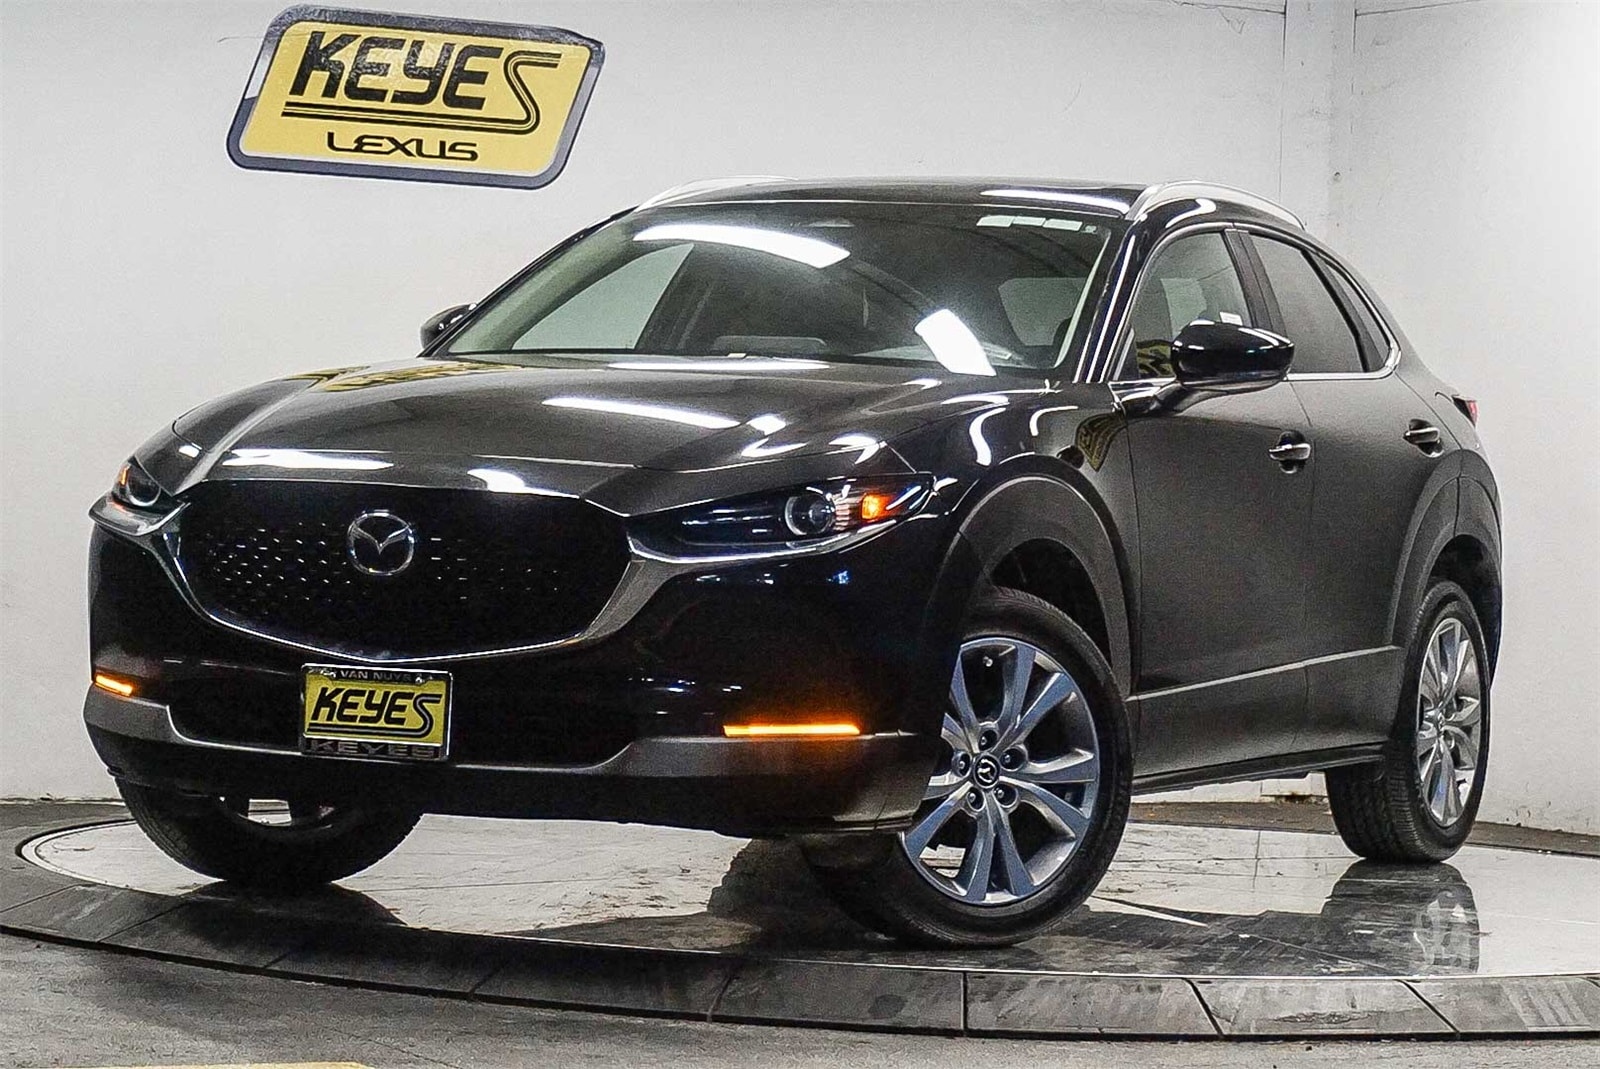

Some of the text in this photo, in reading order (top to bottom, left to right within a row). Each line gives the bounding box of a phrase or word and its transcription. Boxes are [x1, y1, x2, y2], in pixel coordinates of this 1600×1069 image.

[282, 31, 562, 135] KEYES
[327, 131, 479, 162] LEXUS
[340, 670, 411, 682] VAN NUYS
[307, 686, 443, 738] KEYES
[310, 739, 435, 760] KEYES
